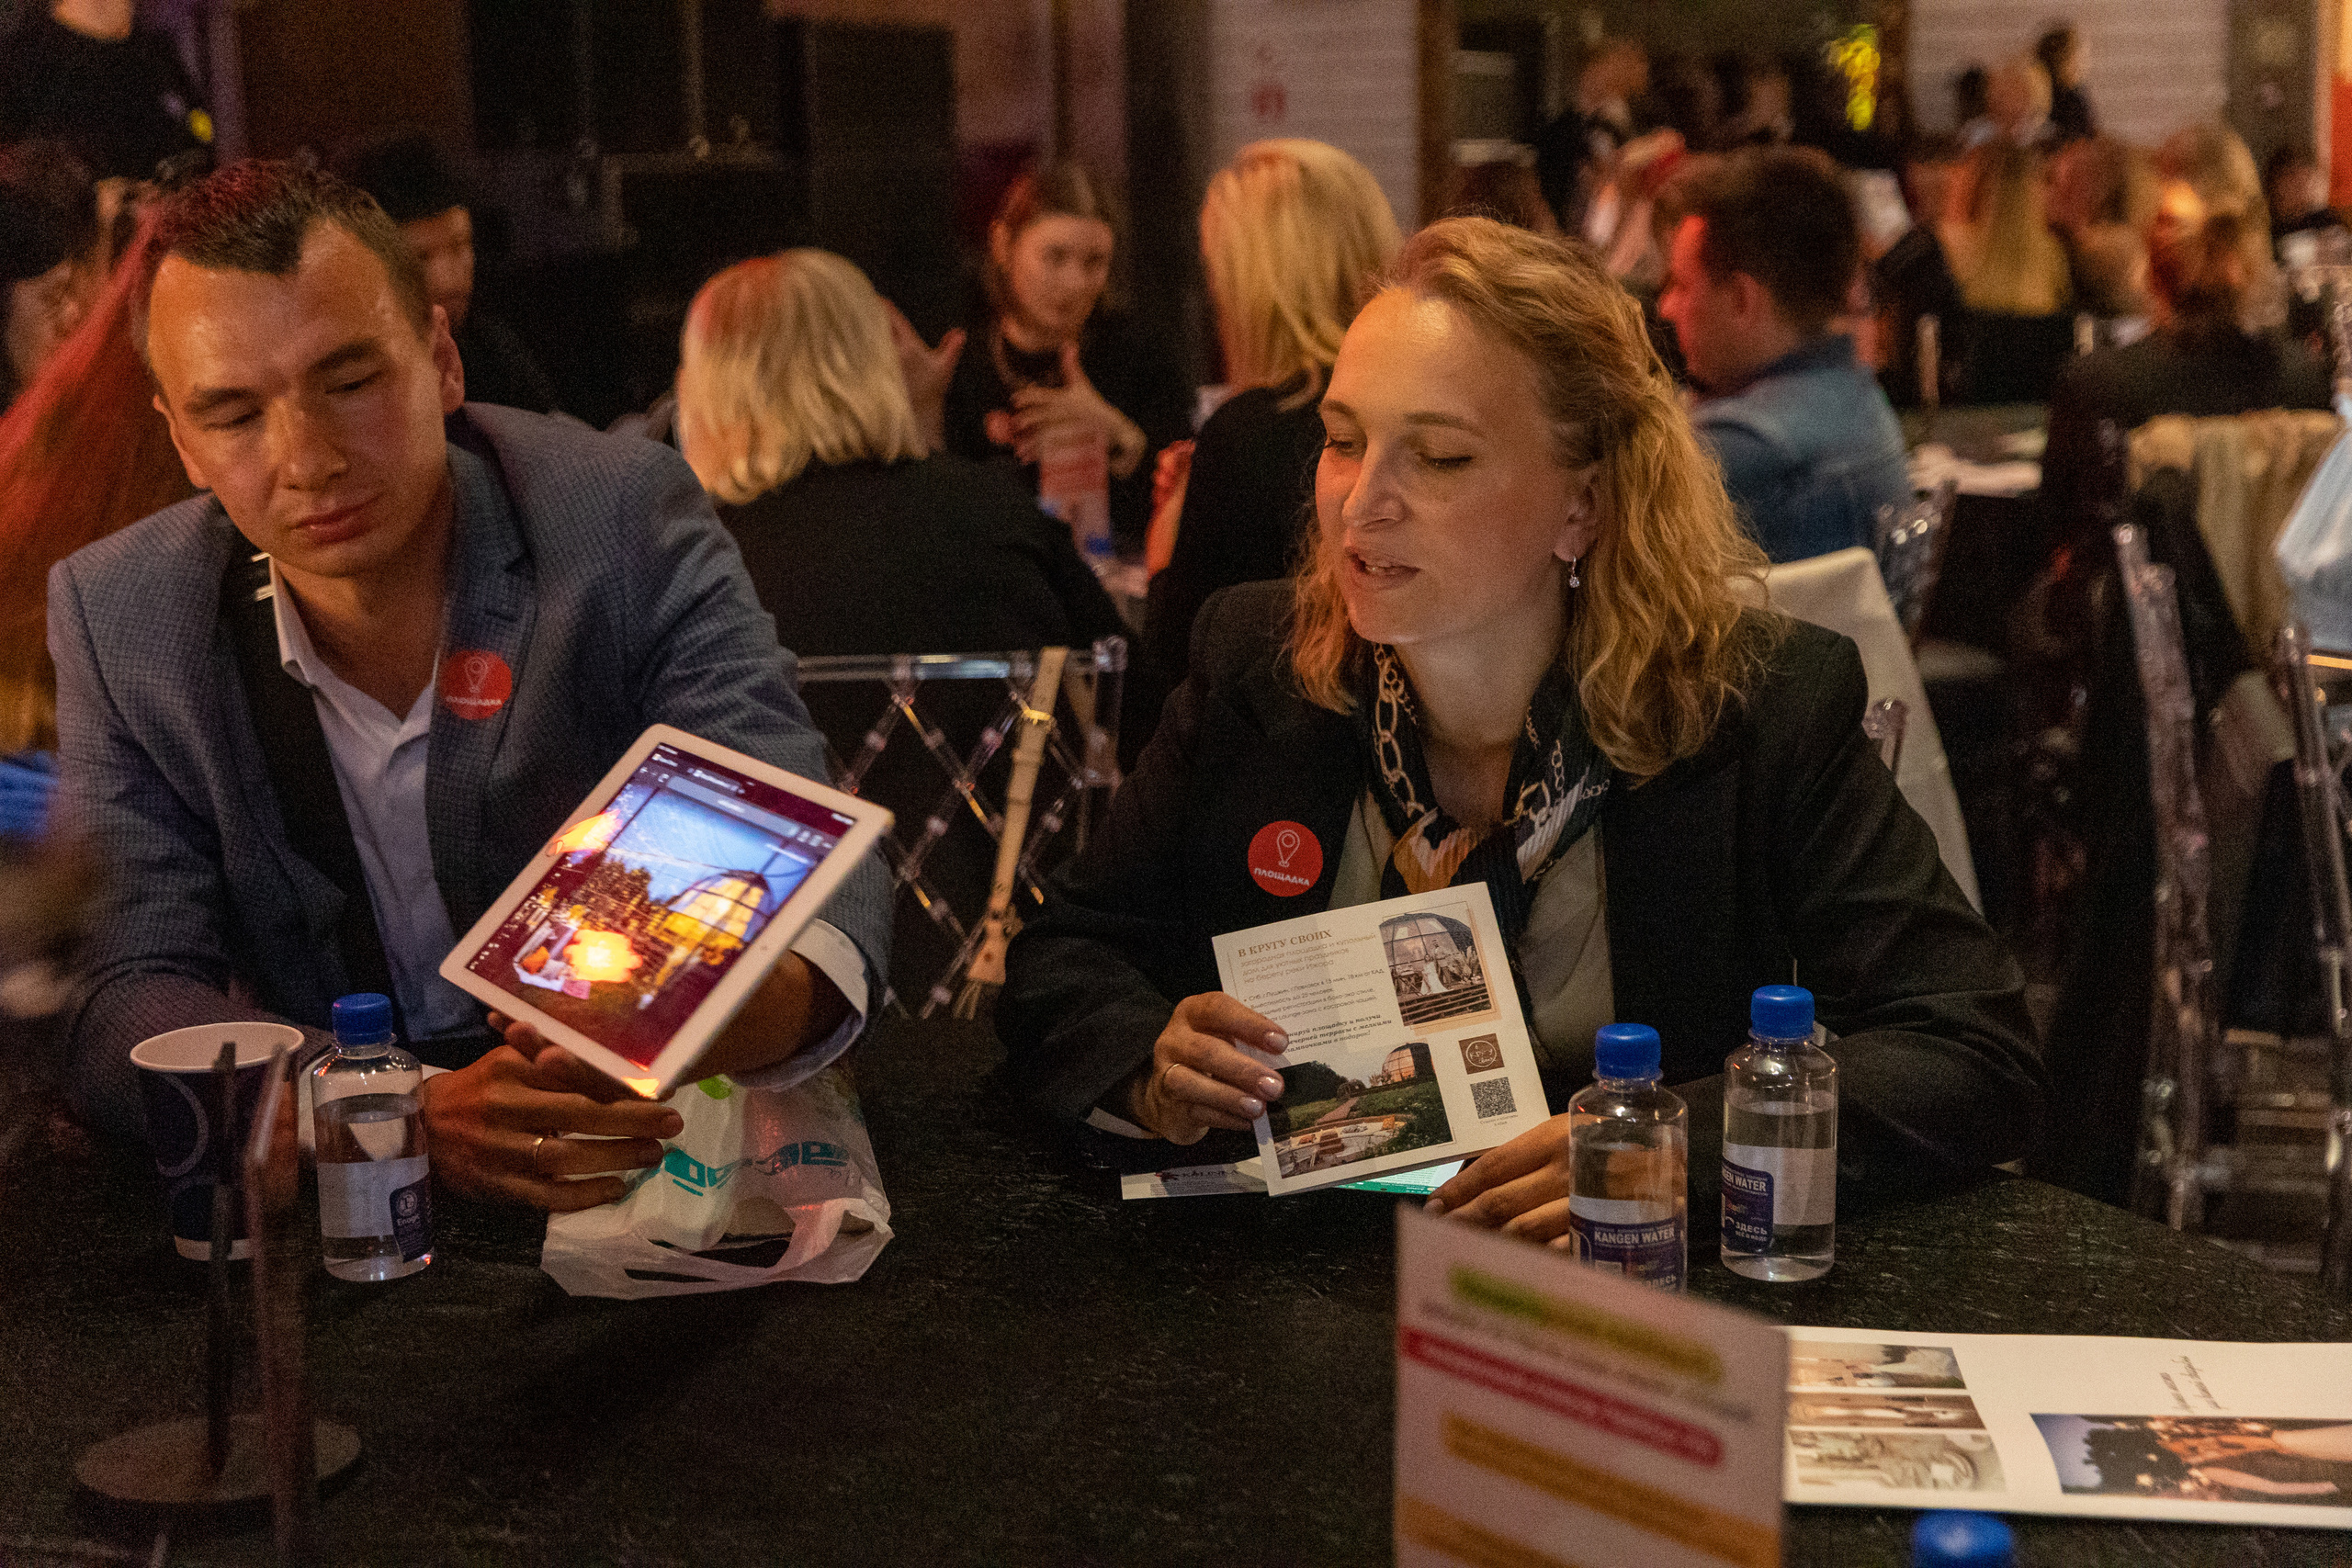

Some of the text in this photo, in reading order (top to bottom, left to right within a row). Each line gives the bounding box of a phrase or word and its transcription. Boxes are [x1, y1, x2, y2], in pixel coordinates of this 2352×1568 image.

[1254, 867, 1310, 886] ПЛОЩАДКА
[1238, 930, 1331, 957] В КРУГУ СВОИХ
[1285, 944, 1328, 956] площадка
[1304, 948, 1349, 962] праздников
[1255, 970, 1283, 980] берегу
[1311, 1021, 1348, 1032] площадку
[1358, 1020, 1391, 1029] мелкими
[1736, 1176, 1766, 1191] WATER
[1736, 1221, 1768, 1235] ЗДЕСЬ
[1594, 1231, 1639, 1245] KANGEN
[1641, 1226, 1674, 1243] WATER
